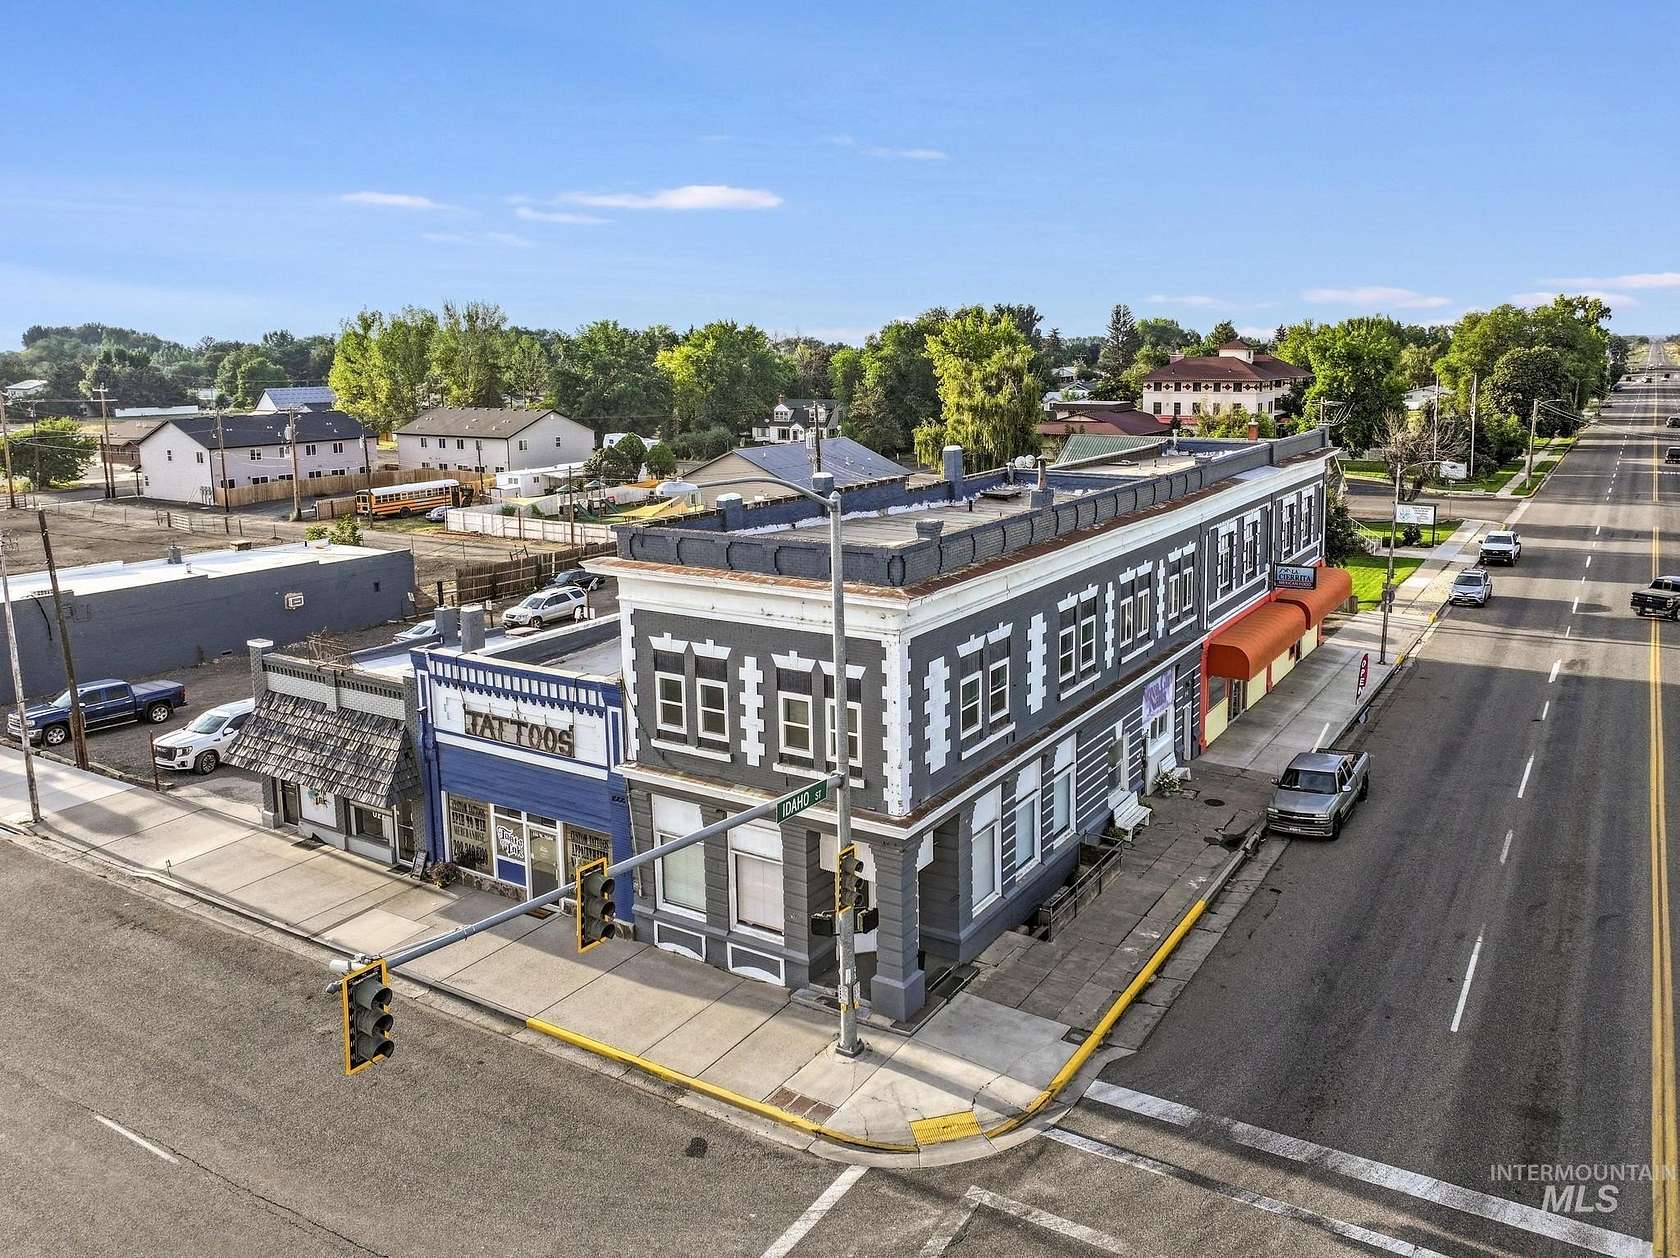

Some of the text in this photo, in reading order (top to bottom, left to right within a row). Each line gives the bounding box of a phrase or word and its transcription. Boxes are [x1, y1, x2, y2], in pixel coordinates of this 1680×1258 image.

[1279, 574, 1311, 582] CIERRITA
[465, 710, 575, 757] TATTOOS
[782, 790, 822, 818] IDAHO ST
